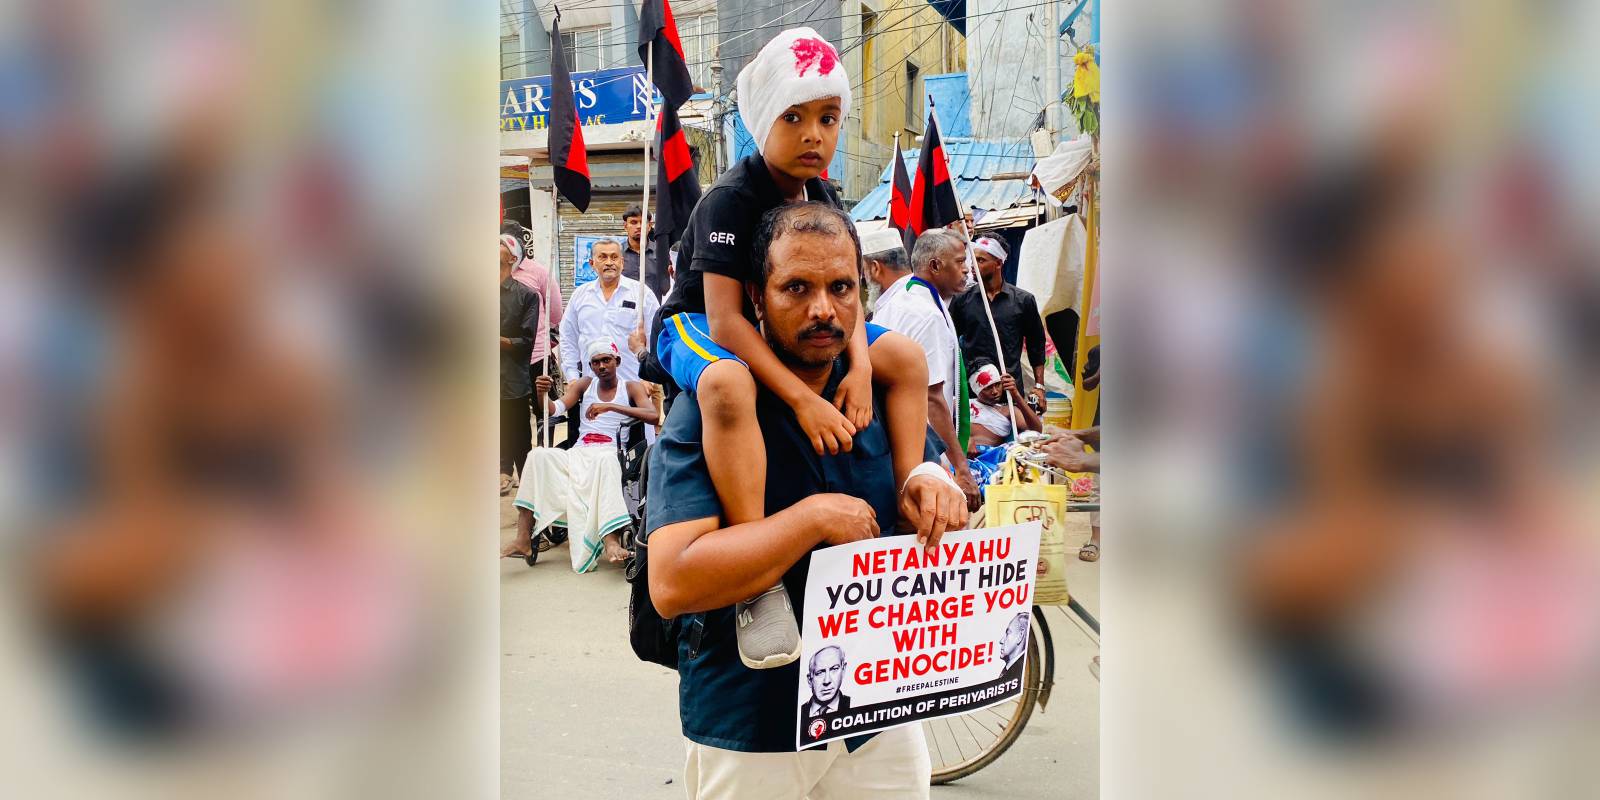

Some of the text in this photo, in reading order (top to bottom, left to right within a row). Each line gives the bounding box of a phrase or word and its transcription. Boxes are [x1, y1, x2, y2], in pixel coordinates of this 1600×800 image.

[709, 231, 736, 246] GER
[852, 537, 1011, 577] NETANYAHU
[826, 559, 1028, 609] YOU CAN'T HIDE
[818, 583, 1029, 639] WE CHARGE YOU
[892, 624, 957, 653] WITH
[854, 642, 994, 685] GENOCIDE!
[831, 707, 912, 731] COALITION
[916, 700, 936, 713] OF
[942, 679, 1019, 708] PERIYARISTS
[896, 677, 959, 693] #FREEPALESTINE
